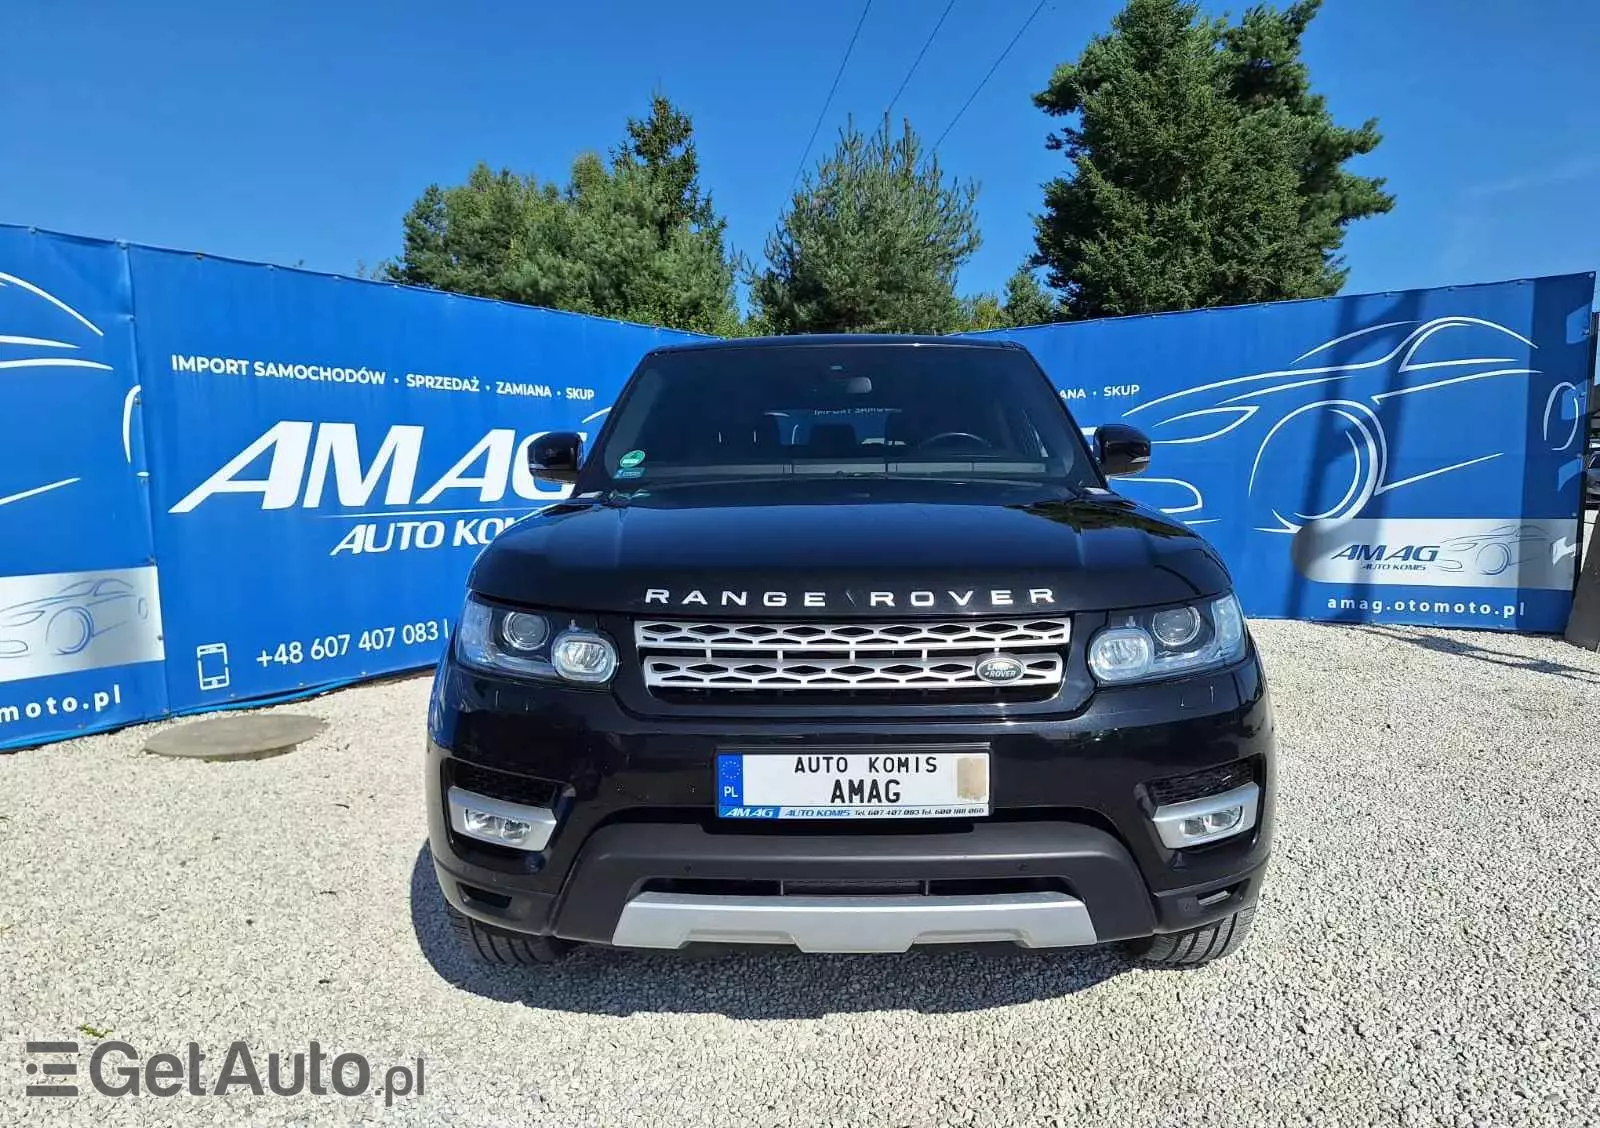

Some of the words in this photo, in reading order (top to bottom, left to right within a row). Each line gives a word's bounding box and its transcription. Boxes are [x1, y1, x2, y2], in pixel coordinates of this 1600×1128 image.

[171, 354, 249, 376] IMPORT
[253, 360, 386, 385] SAMOCHODÓW
[406, 373, 480, 392] SPRZEDAŻ
[496, 381, 552, 398] ZAMIANA
[565, 387, 594, 400] SKUP
[1103, 384, 1140, 397] SKUP
[329, 521, 445, 556] AUTO
[644, 588, 826, 607] RANGE
[870, 588, 1055, 607] ROVER
[1327, 598, 1525, 618] amag.otomoto.pl
[256, 641, 303, 667] +48
[311, 634, 350, 660] 607
[358, 627, 396, 651] 407
[402, 620, 438, 645] 083
[989, 670, 1016, 678] ROVER
[794, 756, 849, 774] AUTO
[868, 756, 938, 774] KOMIS
[724, 786, 739, 798] PL
[830, 779, 901, 804] AMAG
[785, 808, 815, 817] AUTO
[816, 808, 851, 817] KOMIS
